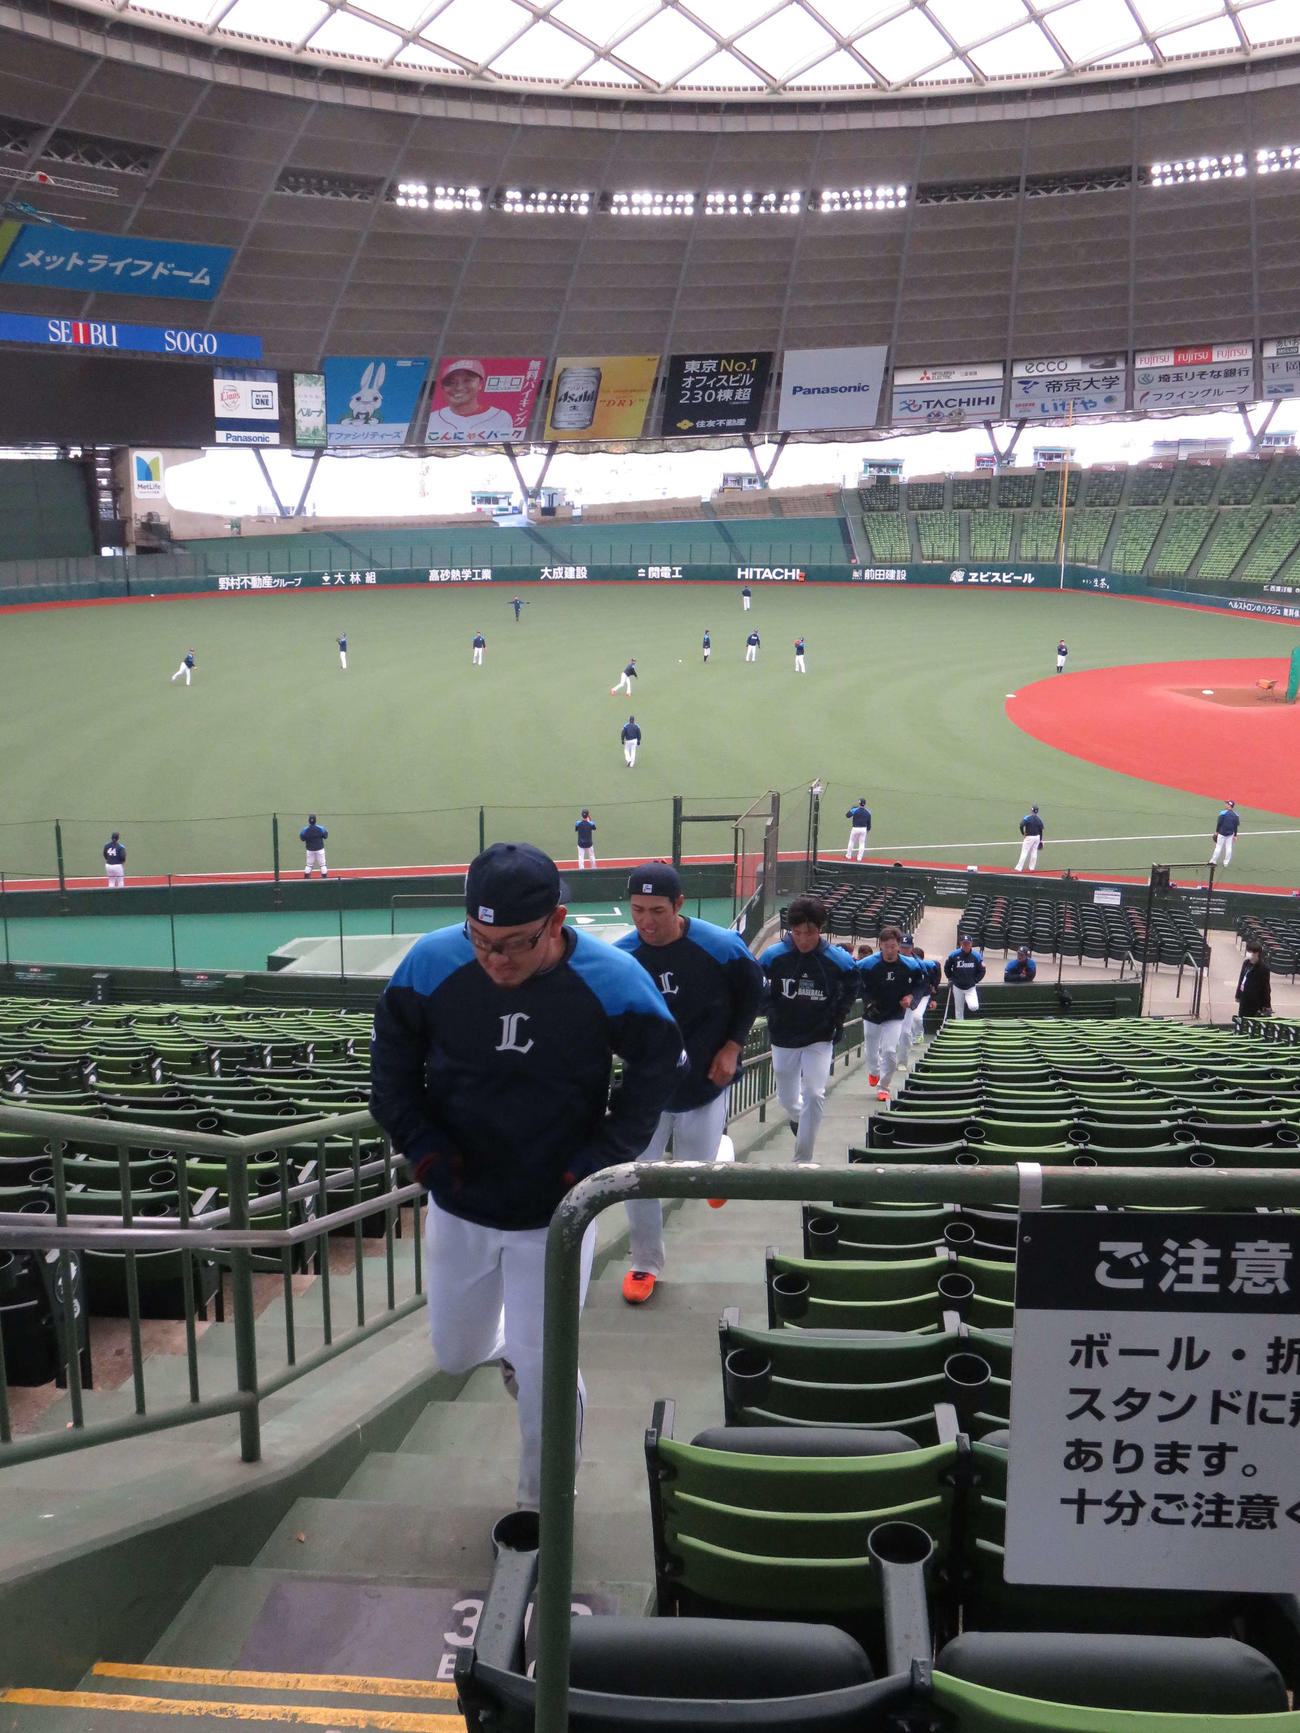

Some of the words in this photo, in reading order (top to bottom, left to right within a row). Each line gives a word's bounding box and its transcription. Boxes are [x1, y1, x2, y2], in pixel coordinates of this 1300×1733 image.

[19, 250, 210, 286] メットライフドーム
[48, 320, 118, 347] SEIBU
[165, 330, 217, 355] SOGO
[1140, 355, 1170, 365] FUJITSU
[1178, 351, 1209, 361] FUJITSU
[1217, 348, 1248, 358] FUJITSU
[1025, 360, 1068, 373] ecco
[682, 373, 754, 388] オフィスビル
[1158, 367, 1249, 383] 埼玉りそな銀行
[791, 382, 870, 396] Panasonic
[1046, 375, 1120, 393] 帝京大学
[680, 388, 752, 404] 230棟超
[1153, 385, 1249, 401] フクイングループ
[255, 398, 269, 406] ONE
[923, 395, 996, 409] TACHIHI
[225, 433, 270, 443] Panasonic
[334, 571, 377, 585] 大林組
[428, 569, 492, 581] 高砂熱学工業
[540, 566, 588, 580] 大成建設
[737, 567, 801, 580] HITACHI
[864, 569, 907, 581] 前田建設
[218, 575, 302, 590] 野村不動産グループ
[659, 971, 679, 995] L
[495, 1012, 535, 1054] L
[1095, 1238, 1293, 1294] ご注意
[1063, 1438, 1257, 1477] あります。
